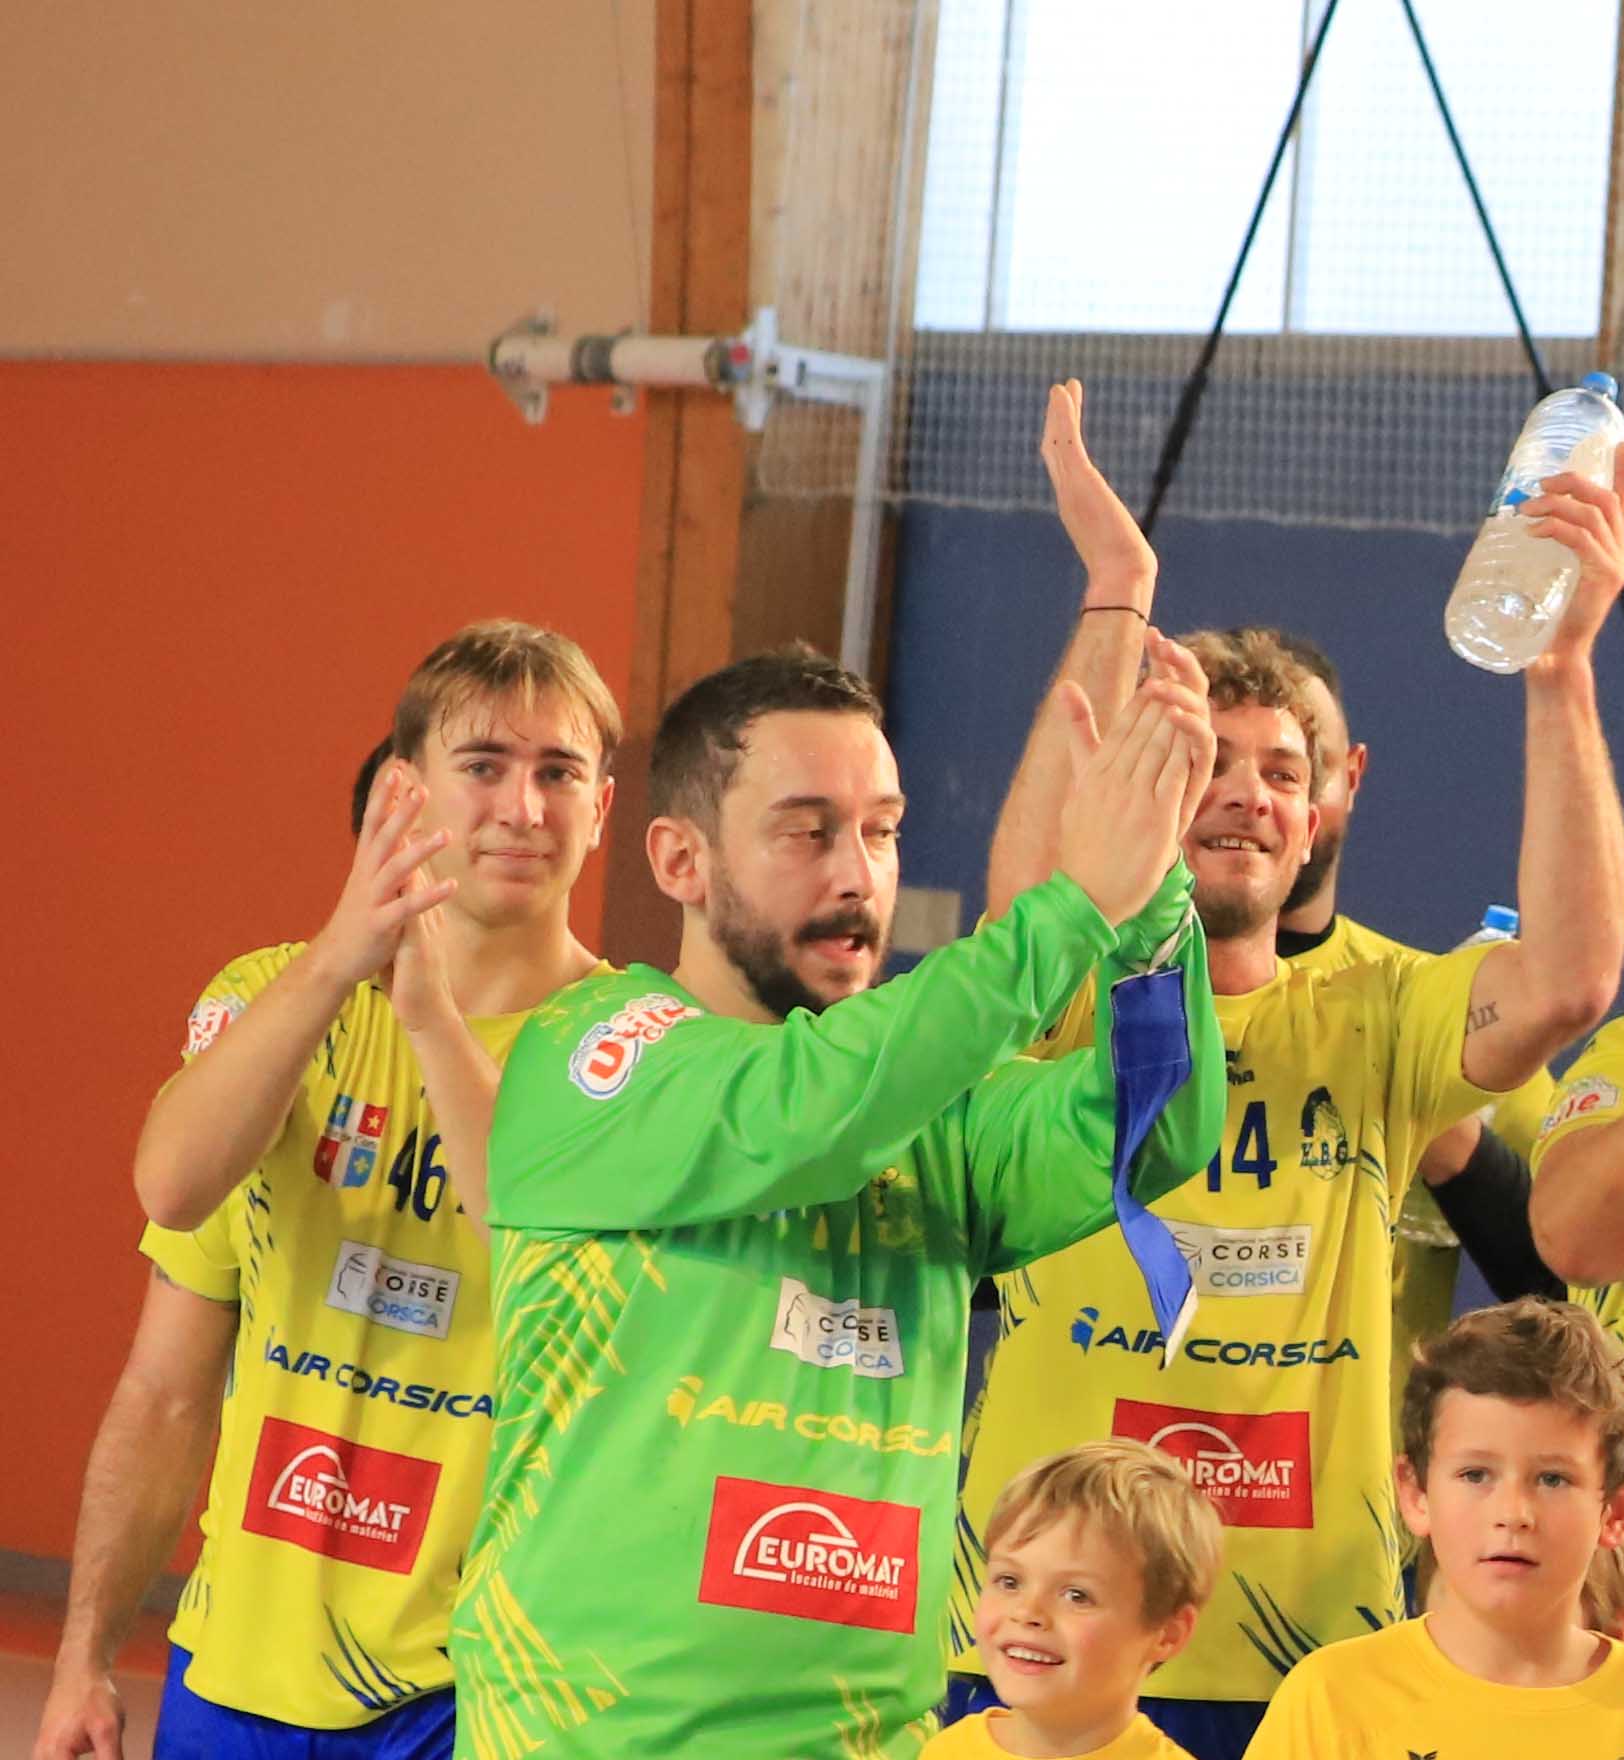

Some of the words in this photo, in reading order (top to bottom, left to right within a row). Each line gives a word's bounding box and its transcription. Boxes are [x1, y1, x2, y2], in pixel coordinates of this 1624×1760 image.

[388, 1127, 447, 1222] 46
[1212, 1241, 1305, 1261] CORSE
[268, 1345, 331, 1381] AIR
[335, 1363, 496, 1420] CORSICA
[696, 1395, 789, 1431] AIR
[757, 1535, 906, 1586] EUROMAT
